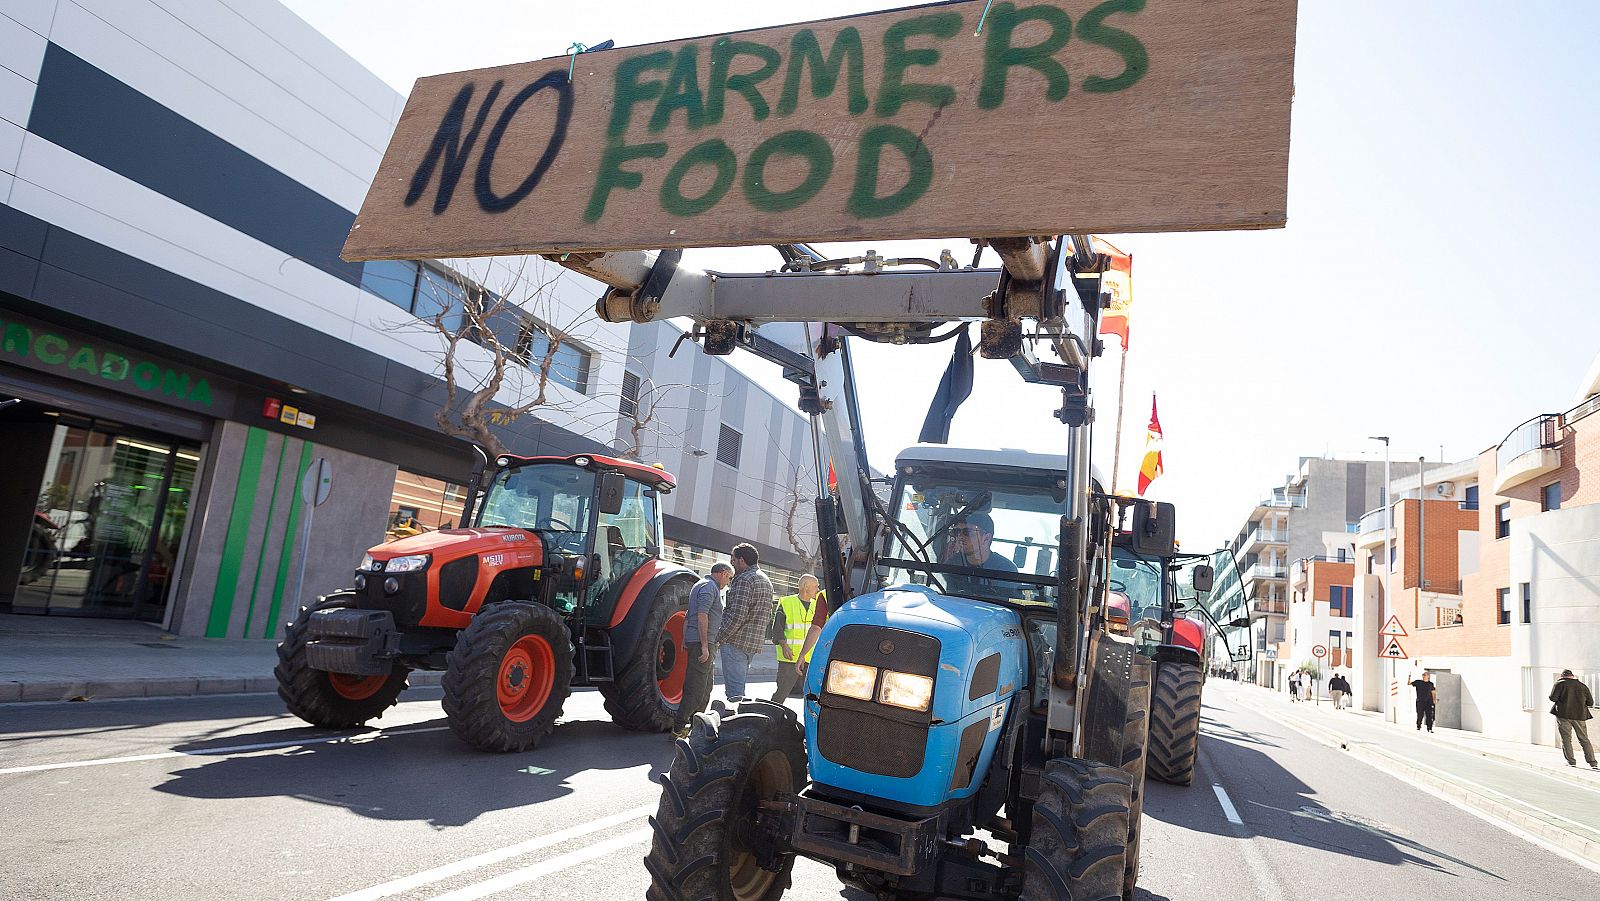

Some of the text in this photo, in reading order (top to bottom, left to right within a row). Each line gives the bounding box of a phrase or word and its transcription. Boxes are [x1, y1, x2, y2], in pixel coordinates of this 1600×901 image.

[404, 0, 1149, 214] NO FARMERS
[584, 124, 934, 223] FOOD
[0, 318, 213, 408] RCADONA
[502, 534, 525, 542] KUBOTA
